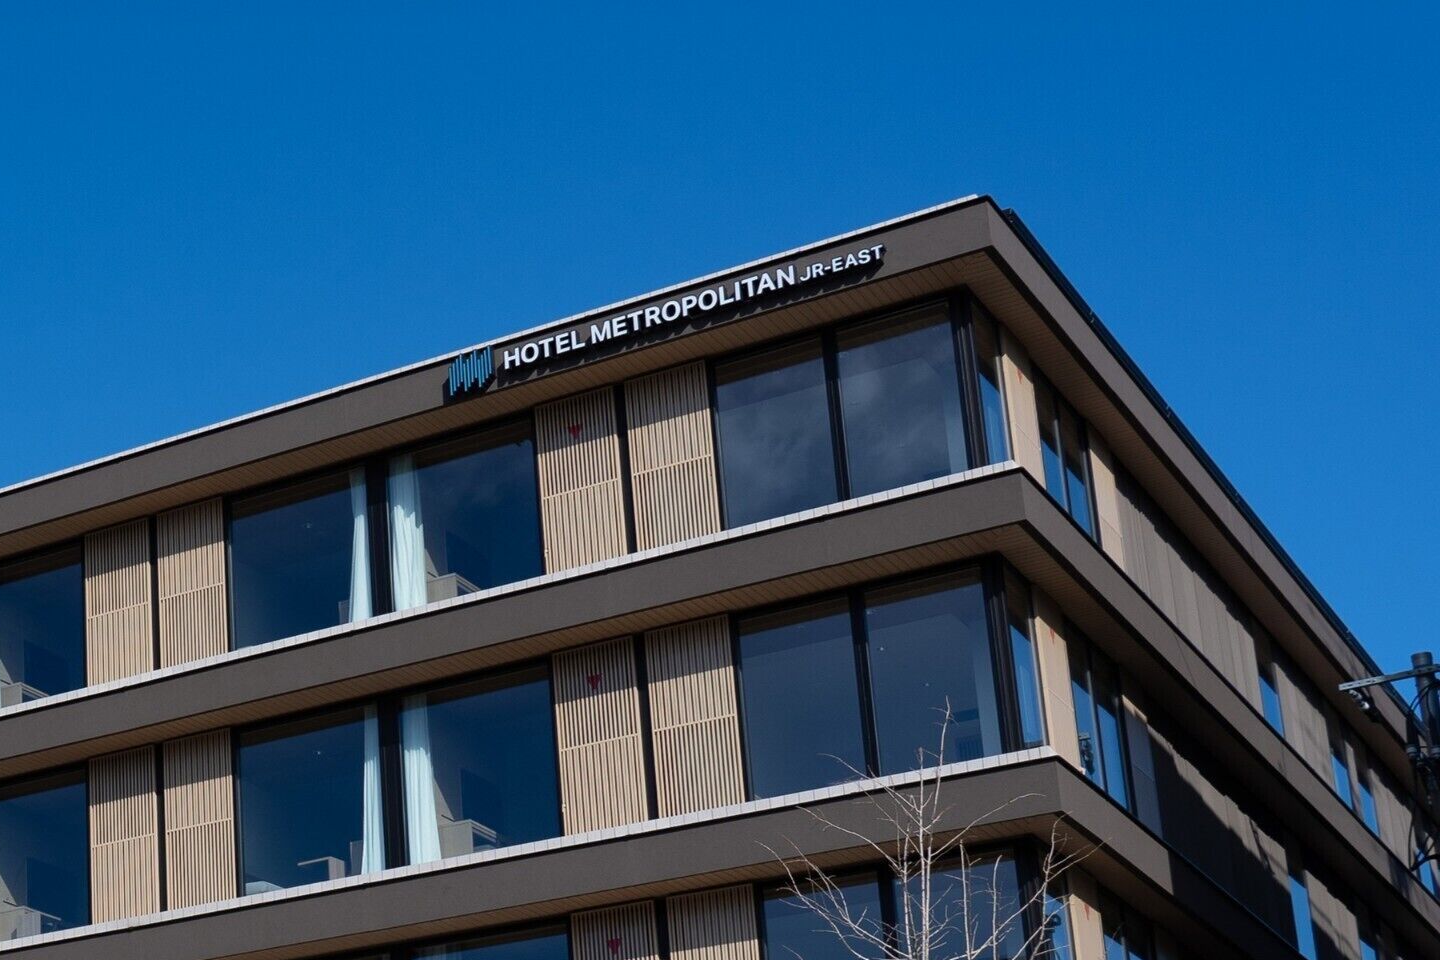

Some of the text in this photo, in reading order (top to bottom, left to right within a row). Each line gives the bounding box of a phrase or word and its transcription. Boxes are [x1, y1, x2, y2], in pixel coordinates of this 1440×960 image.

[503, 243, 885, 370] HOTEL METROPOLITAN JR-EAST
